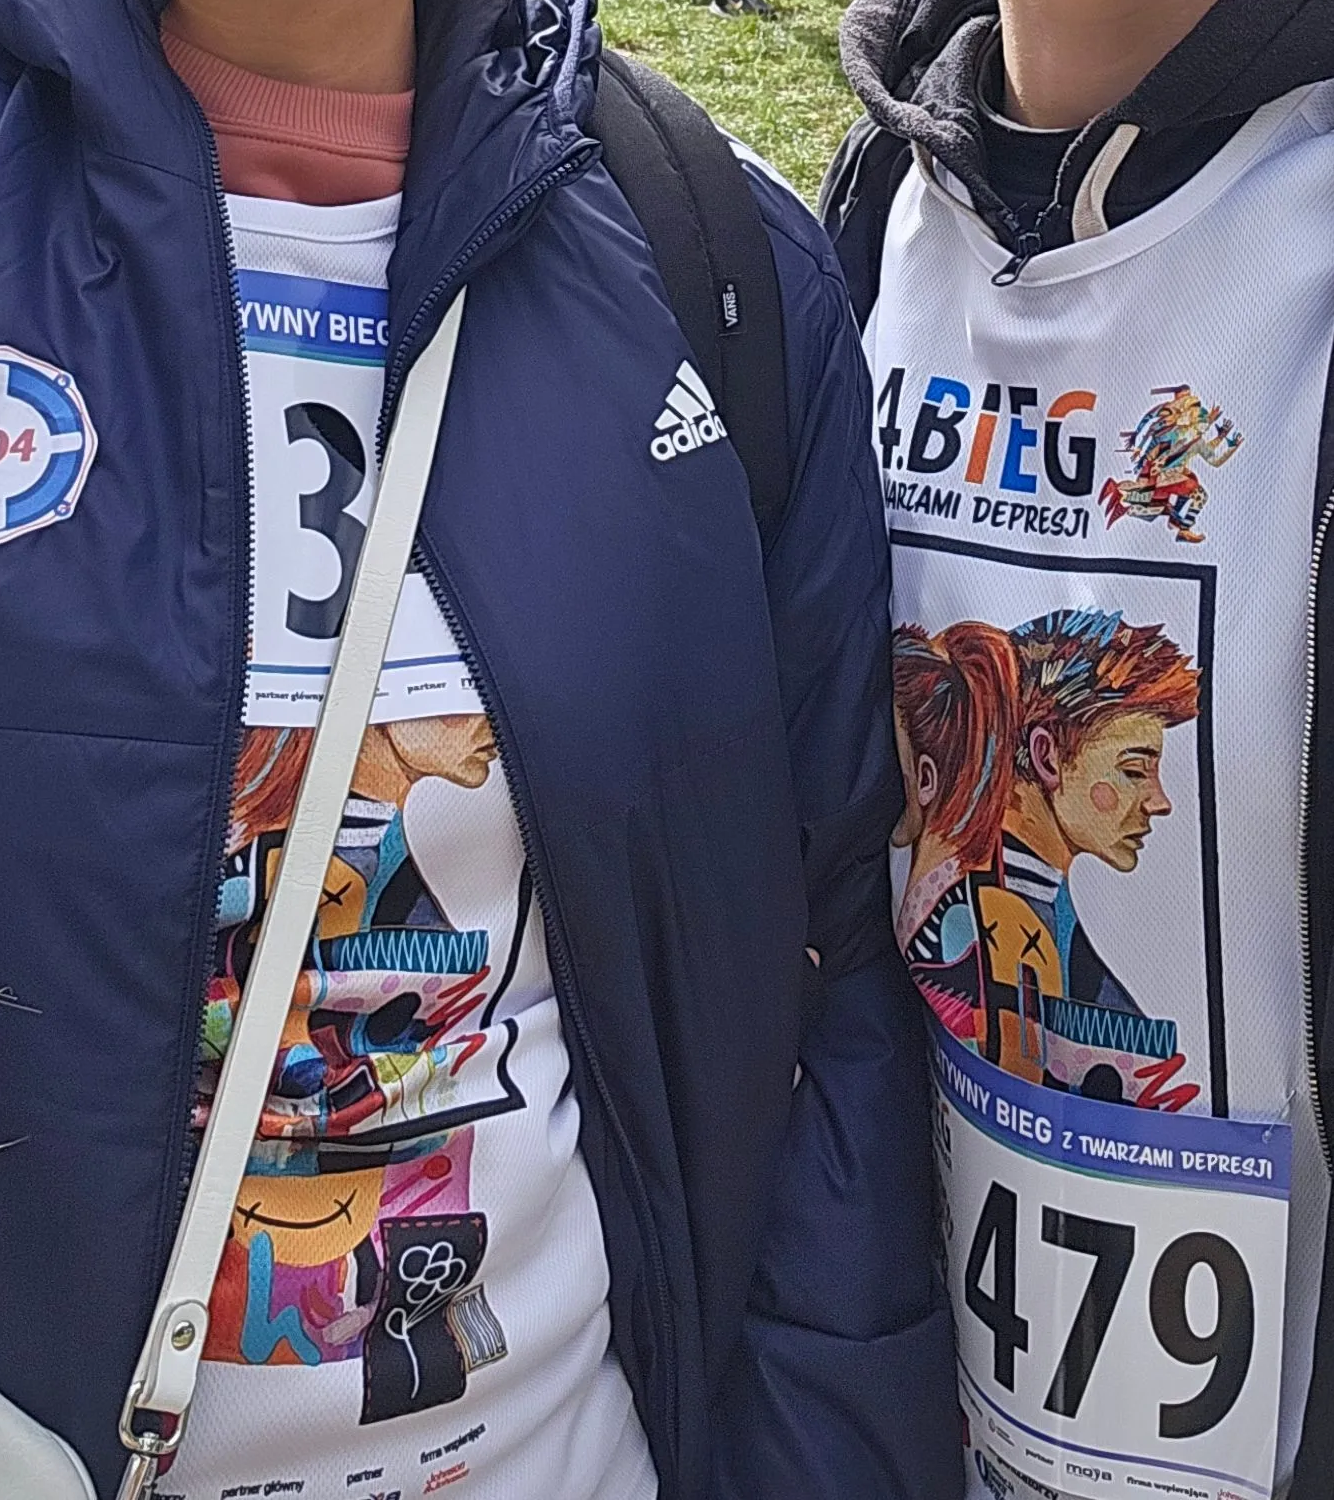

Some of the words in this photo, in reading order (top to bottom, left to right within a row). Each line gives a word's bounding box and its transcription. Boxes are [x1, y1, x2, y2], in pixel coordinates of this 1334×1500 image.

[972, 496, 1090, 539] DEPRESJI
[996, 1097, 1053, 1145] BIEG
[1079, 1134, 1174, 1169] TWARZAMI
[1180, 1151, 1273, 1180] DEPRESJI
[964, 1180, 1255, 1440] 479
[221, 1481, 262, 1500] partner
[347, 1467, 385, 1487] partner
